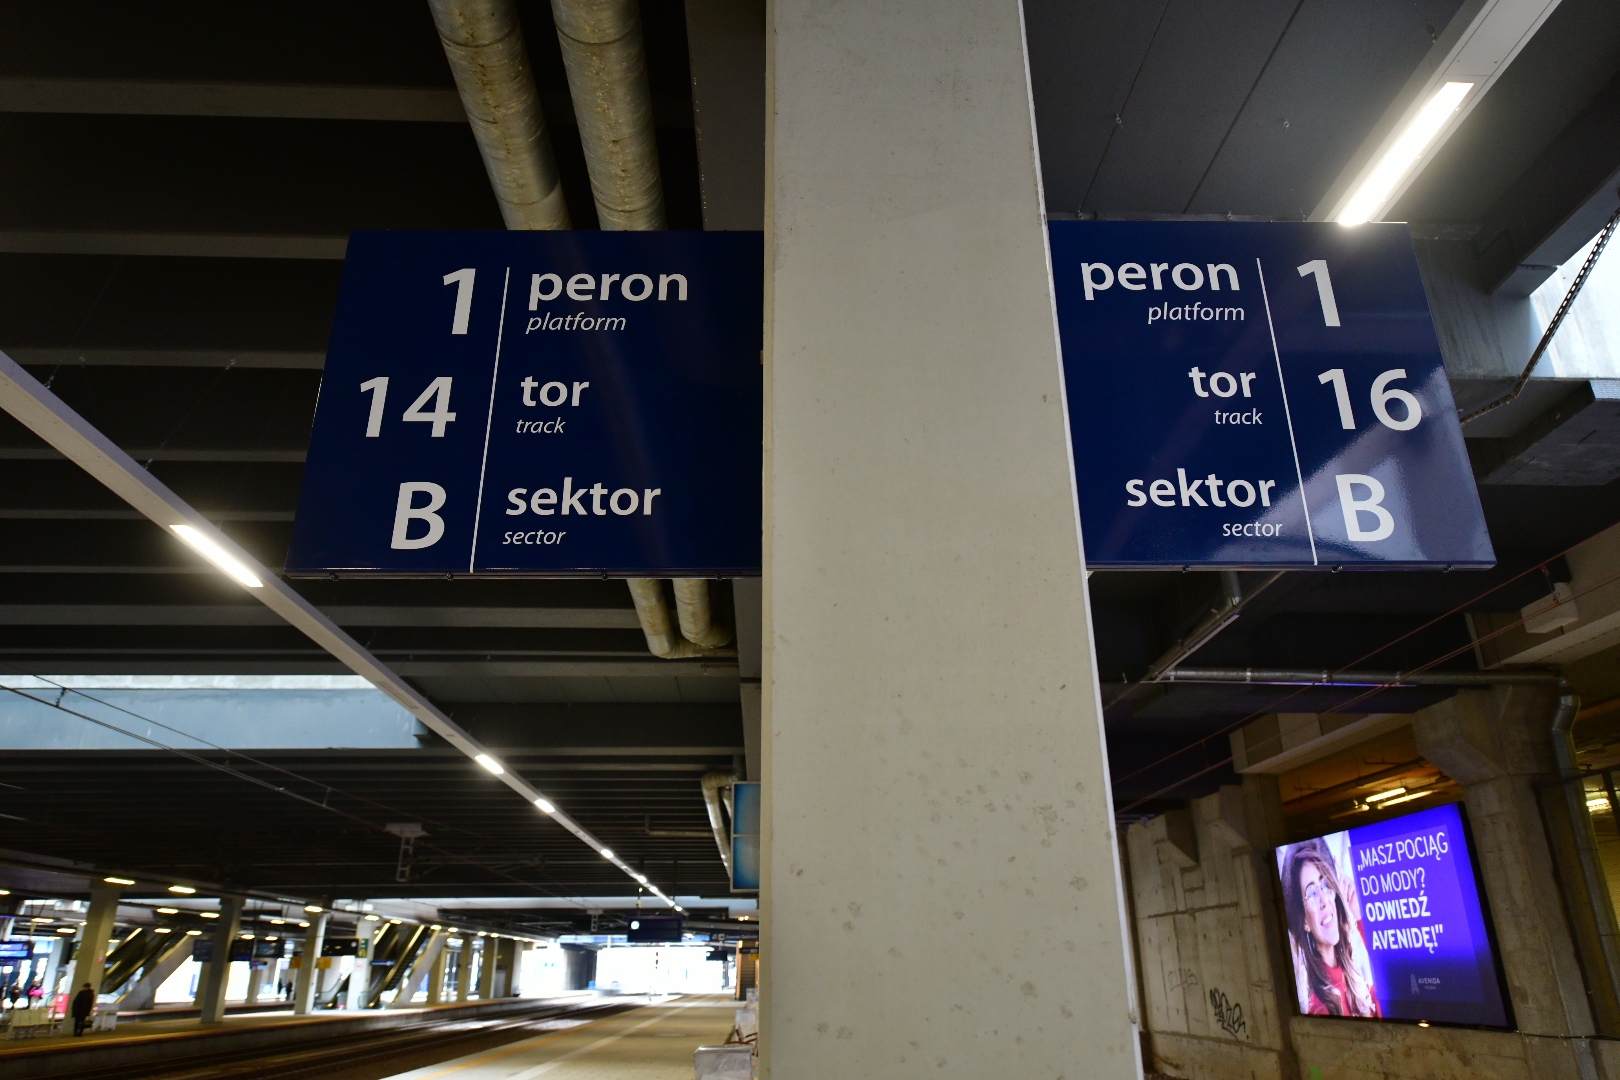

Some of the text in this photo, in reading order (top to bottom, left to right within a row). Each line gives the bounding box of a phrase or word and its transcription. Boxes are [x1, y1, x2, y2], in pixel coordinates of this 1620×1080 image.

[442, 268, 688, 335] 1 peron
[1080, 259, 1341, 327] peron 1
[525, 312, 627, 335] platform
[1147, 301, 1245, 325] platform
[360, 375, 590, 438] 14 tor
[1188, 366, 1422, 431] tor 16
[515, 416, 567, 434] track
[1213, 407, 1263, 425] track
[390, 476, 661, 550] B sektor
[1125, 468, 1395, 542] sektor B
[502, 529, 566, 545] sector
[1222, 520, 1283, 537] sector
[1357, 832, 1449, 871] „MASZ POCIĄG
[1360, 867, 1426, 896] DO MODY?
[1365, 889, 1431, 923] ODWIEDŹ
